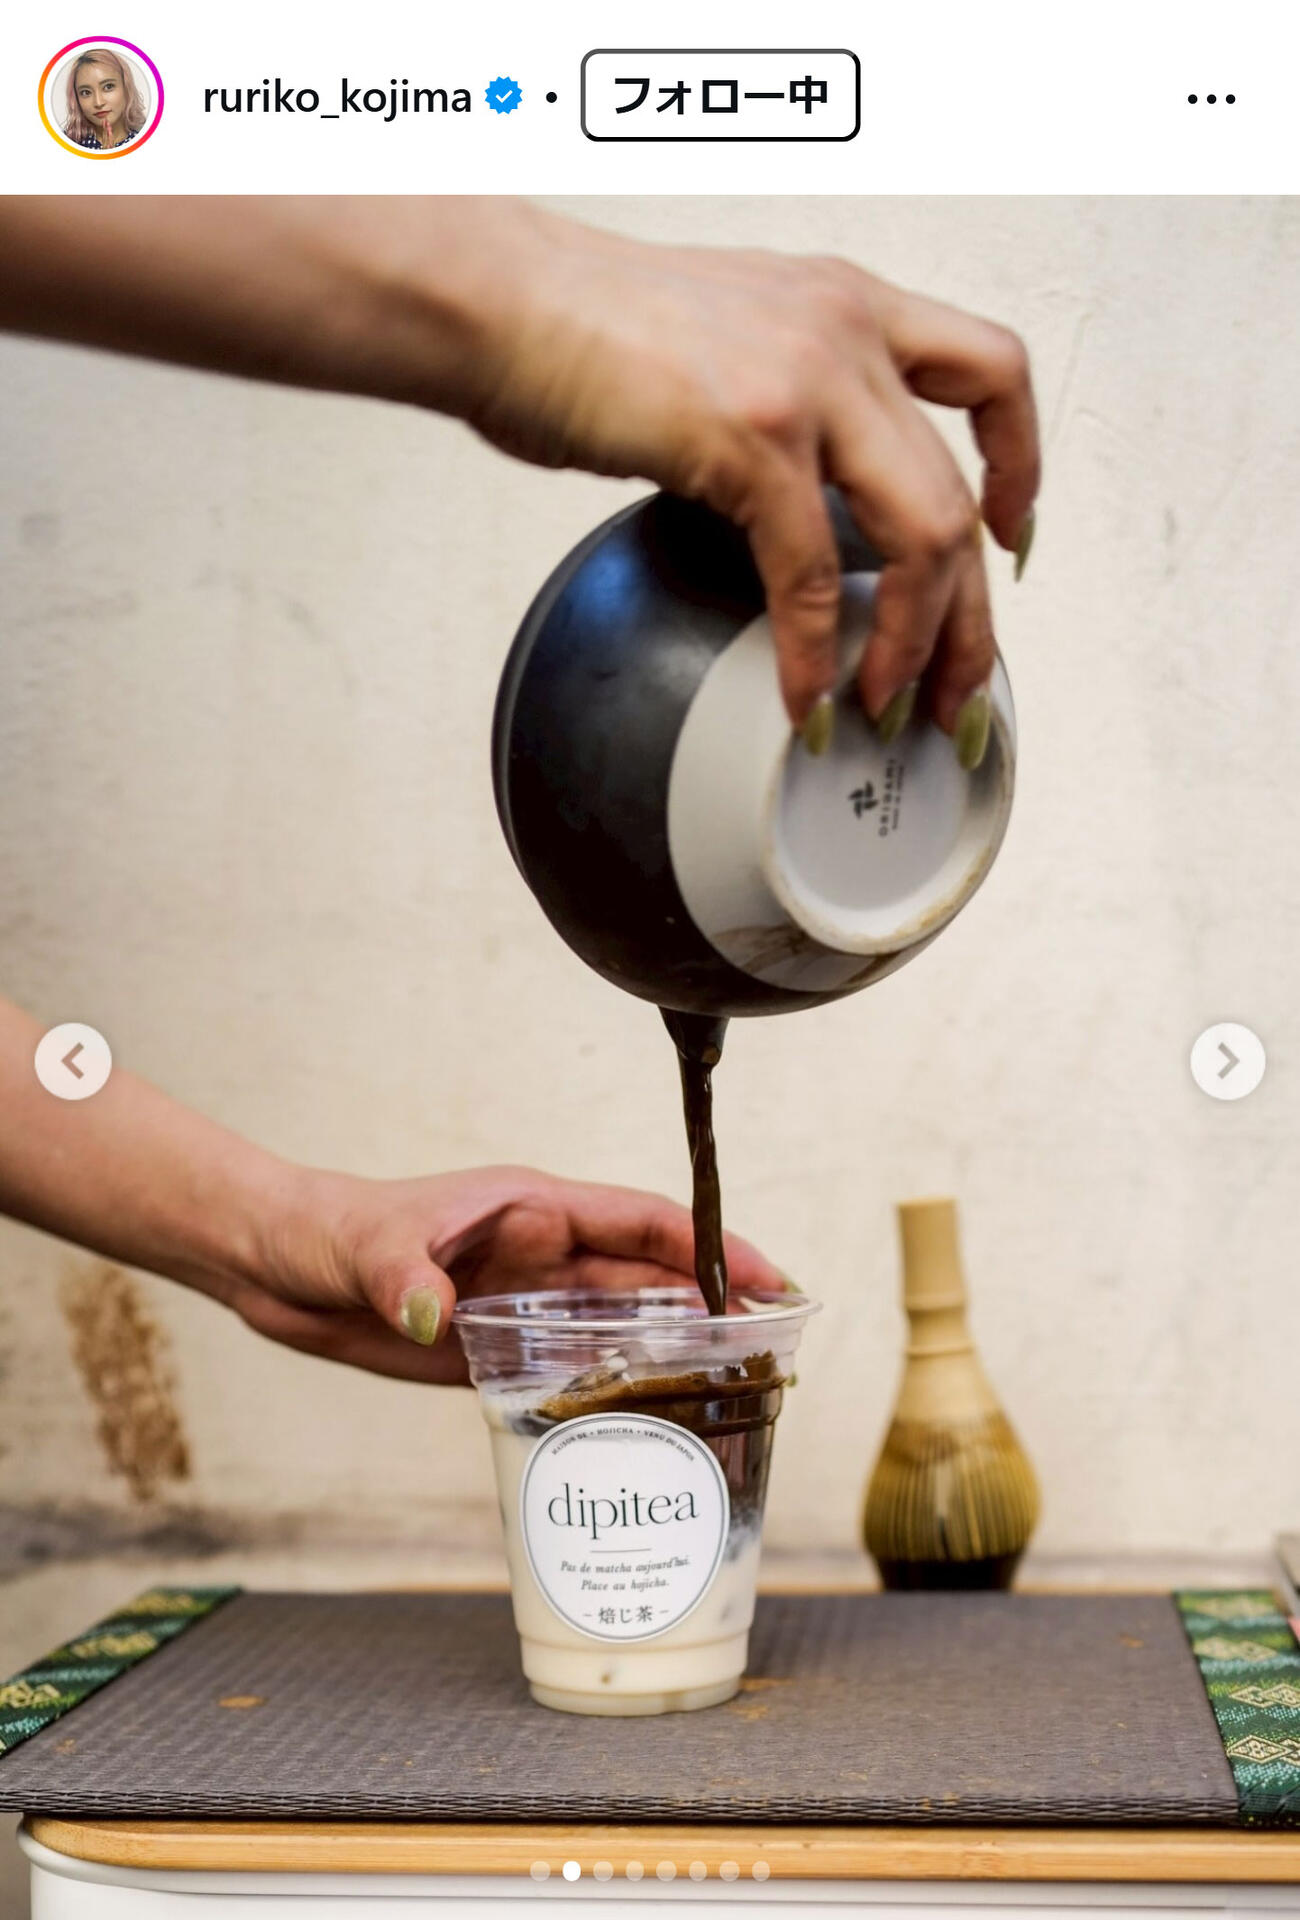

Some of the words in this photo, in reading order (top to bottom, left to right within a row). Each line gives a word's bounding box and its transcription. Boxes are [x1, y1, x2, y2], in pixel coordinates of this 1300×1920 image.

[577, 1432, 588, 1440] DE
[597, 1427, 634, 1435] HOJICHA
[644, 1430, 665, 1441] VENU
[665, 1437, 677, 1447] DU
[548, 1482, 700, 1540] dipitea
[560, 1561, 576, 1572] Pas
[580, 1561, 591, 1573] de
[595, 1561, 632, 1573] matcha
[581, 1579, 608, 1591] Place
[613, 1581, 626, 1590] au
[631, 1578, 670, 1592] hojicha.
